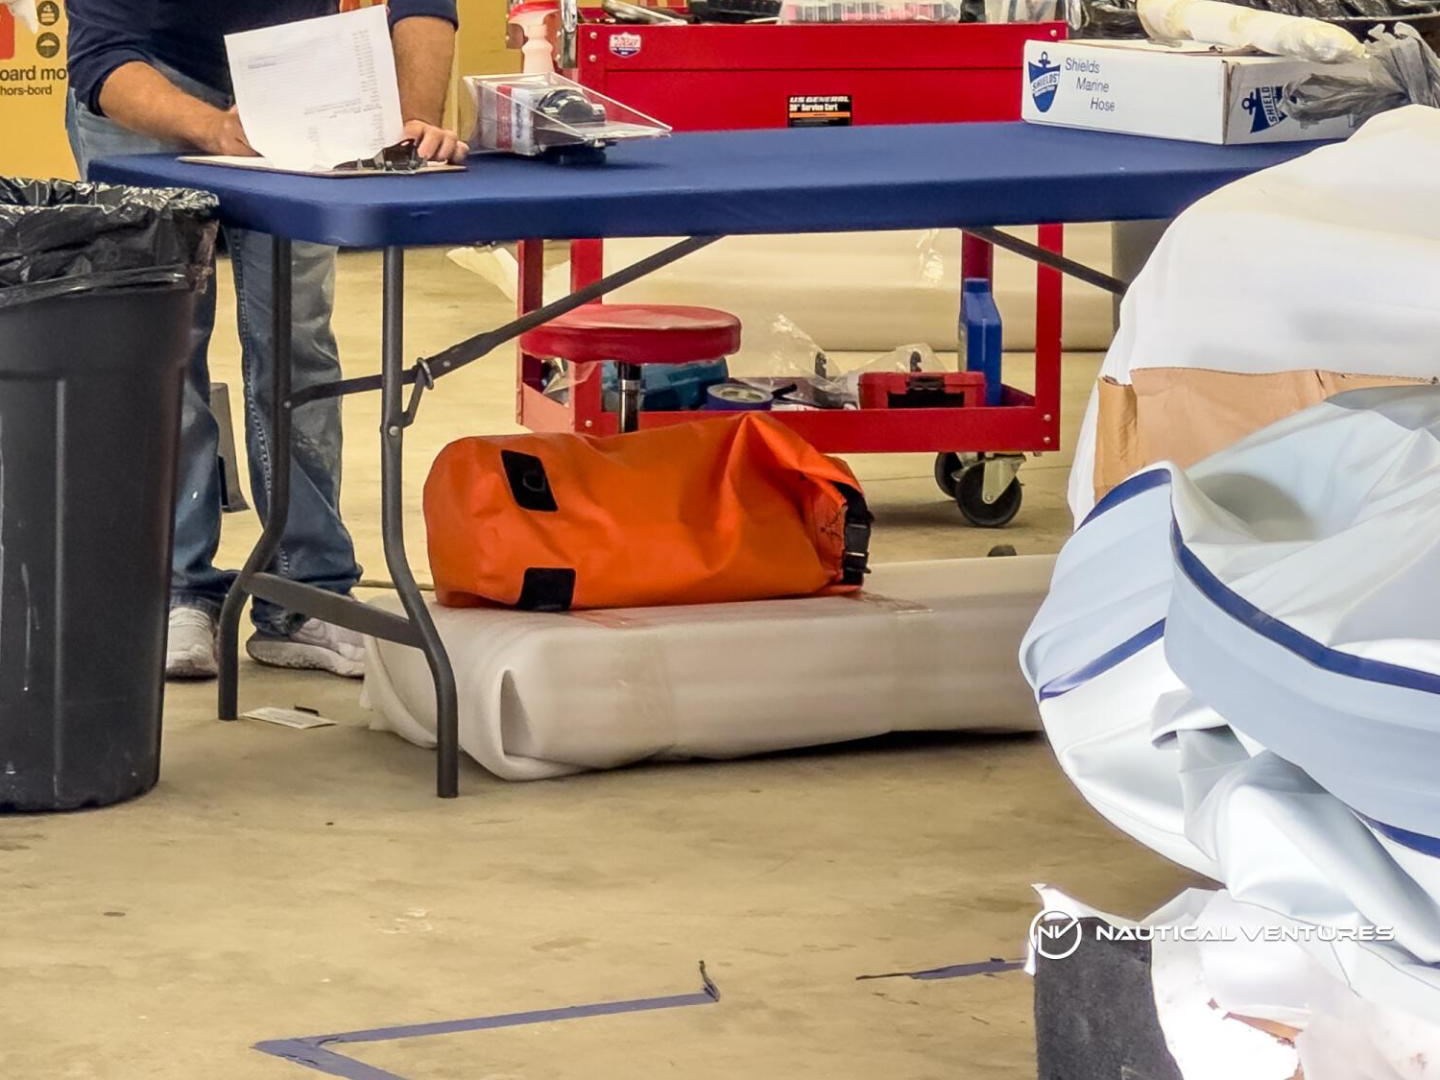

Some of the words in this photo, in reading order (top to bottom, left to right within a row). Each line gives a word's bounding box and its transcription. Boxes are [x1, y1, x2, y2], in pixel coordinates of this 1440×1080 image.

[1065, 57, 1100, 74] Shields
[0, 85, 52, 96] hors-bord
[1076, 77, 1109, 93] Marine
[1090, 97, 1115, 112] Hose
[1261, 86, 1279, 123] SHIELD
